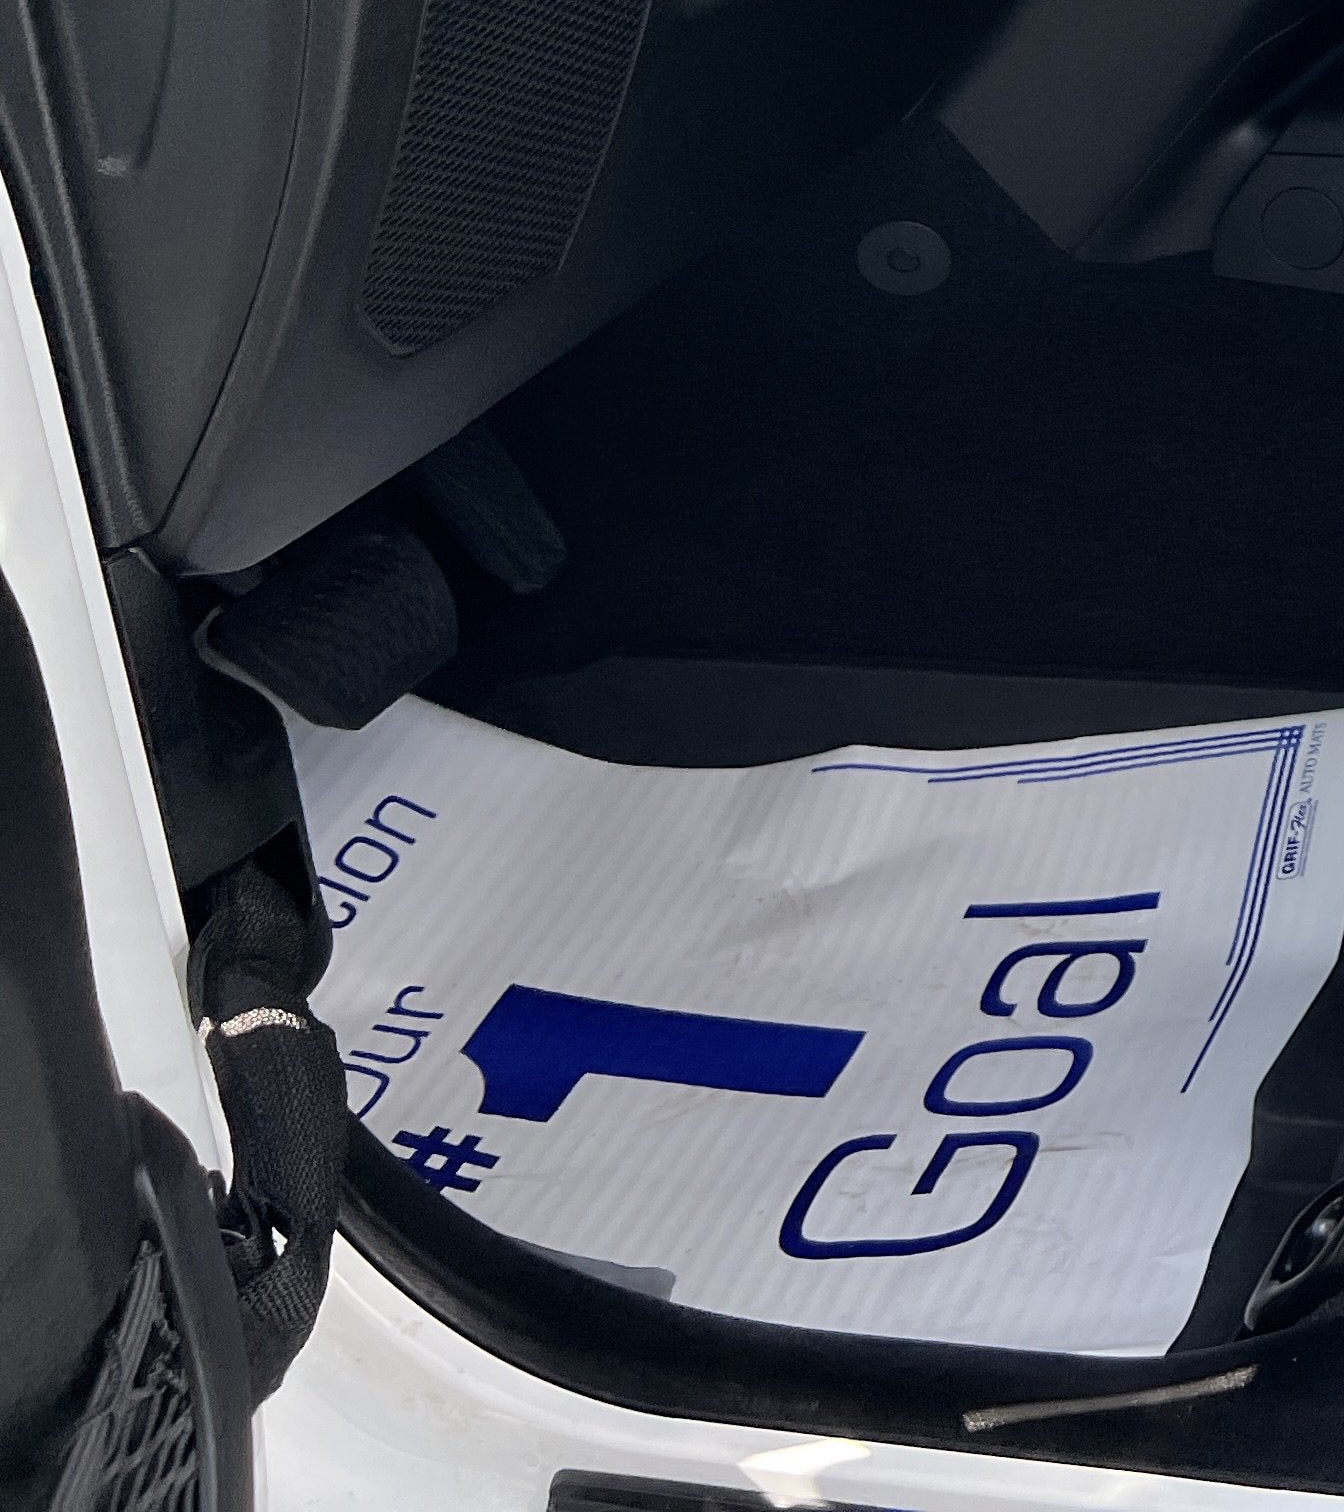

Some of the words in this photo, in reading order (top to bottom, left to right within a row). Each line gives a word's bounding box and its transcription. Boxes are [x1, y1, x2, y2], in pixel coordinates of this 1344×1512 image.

[1299, 757, 1318, 794] AUTO
[1309, 722, 1328, 754] MATS
[779, 892, 1160, 1259] Goal
